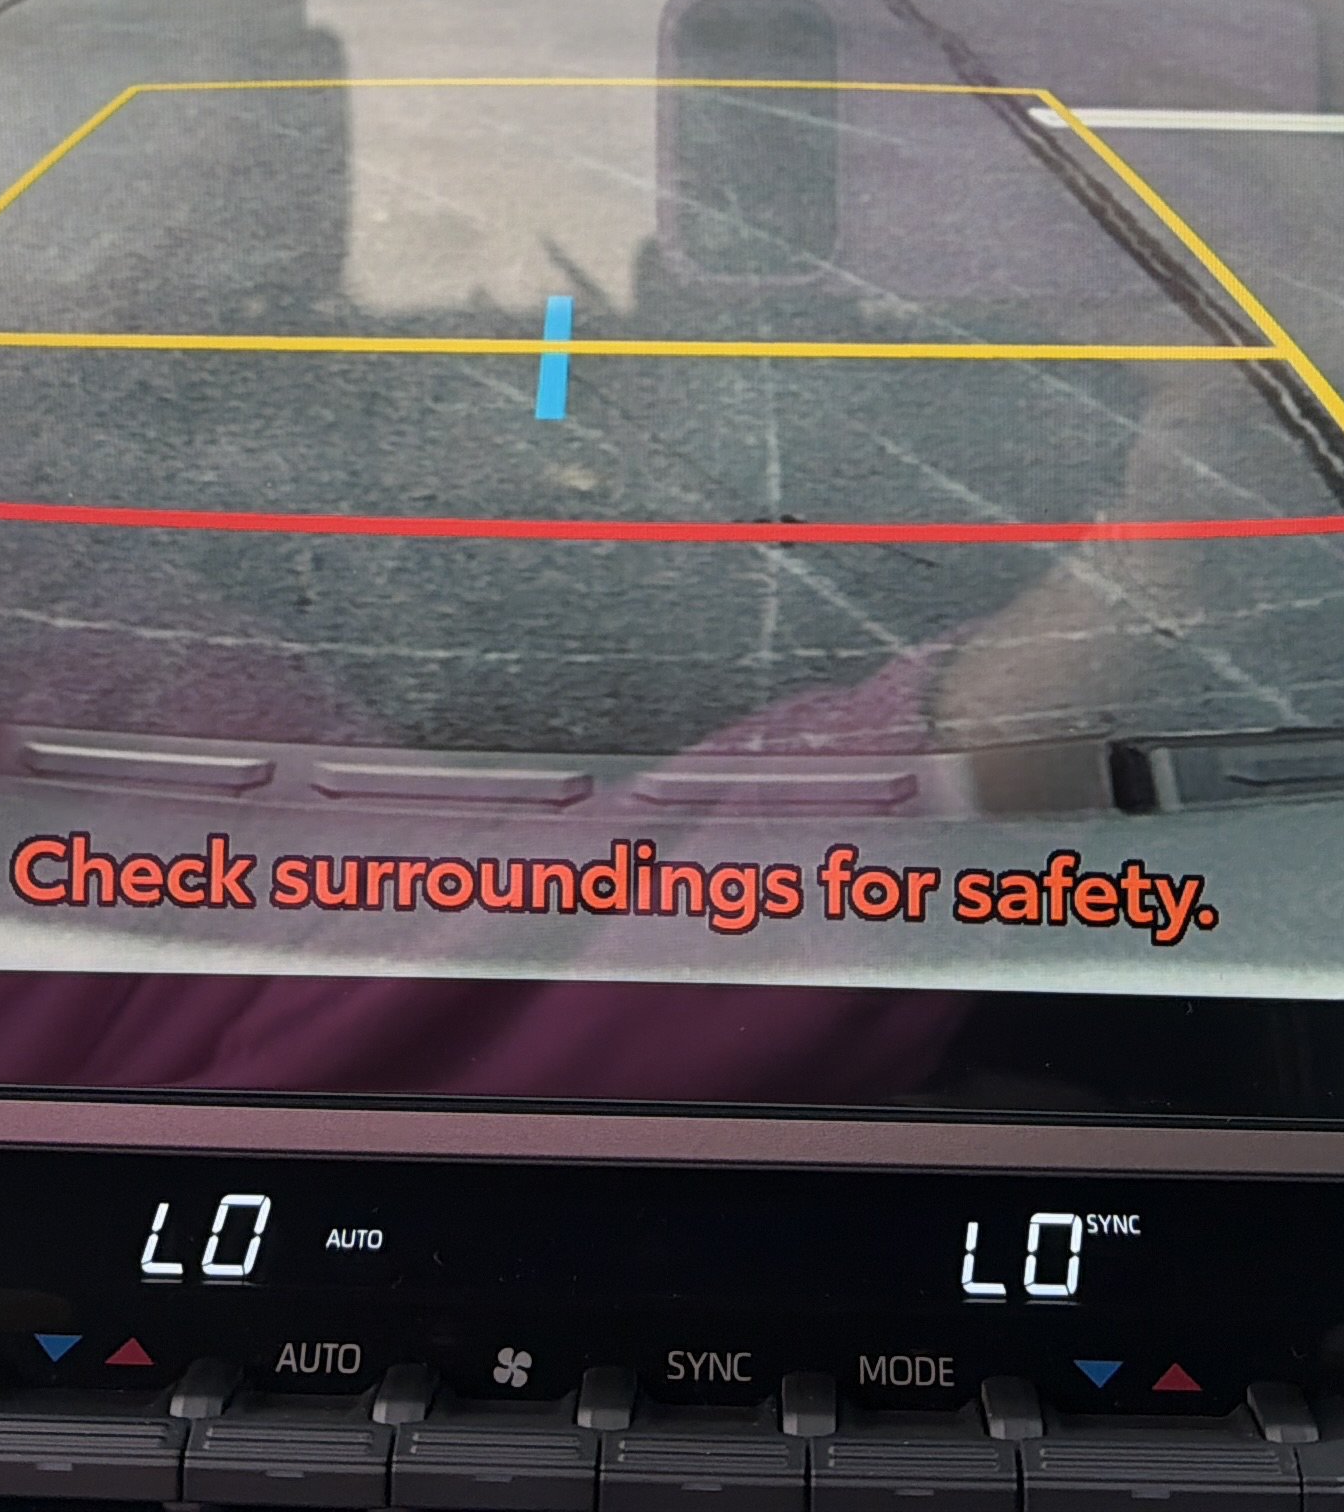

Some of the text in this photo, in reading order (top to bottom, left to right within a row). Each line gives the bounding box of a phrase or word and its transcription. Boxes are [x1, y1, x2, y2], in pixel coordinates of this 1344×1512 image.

[11, 831, 1221, 946] Check surroundings for safety.
[140, 1193, 272, 1277] LO
[325, 1228, 384, 1250] AUTO
[1086, 1213, 1142, 1236] SYNC
[961, 1212, 1083, 1298] LO
[275, 1342, 362, 1375] AUTO
[666, 1351, 752, 1383] SYNC
[859, 1355, 955, 1387] MODE
